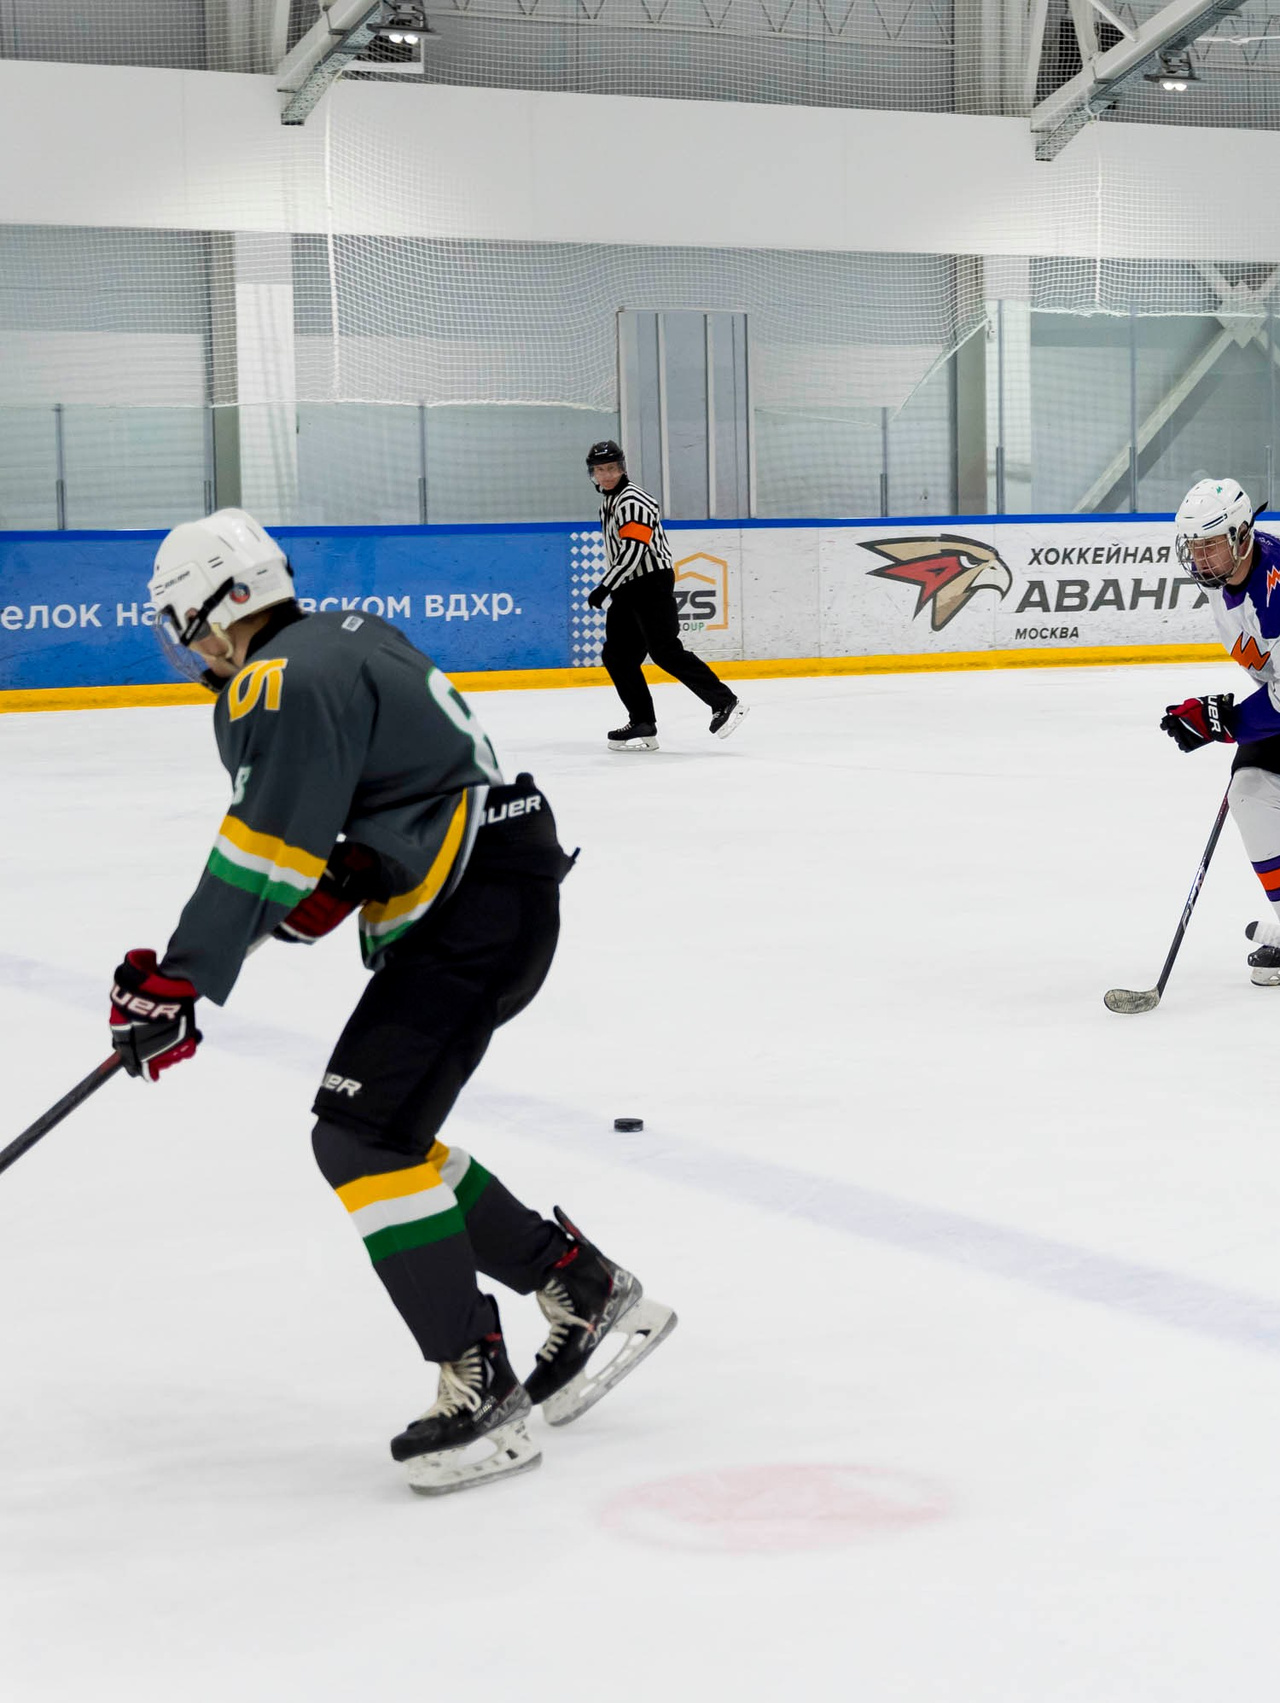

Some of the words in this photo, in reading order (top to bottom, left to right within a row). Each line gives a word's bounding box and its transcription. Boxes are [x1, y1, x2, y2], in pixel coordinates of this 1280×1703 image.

[1028, 543, 1171, 566] ХОККЕЙНАЯ
[0, 603, 102, 631] елок
[425, 592, 523, 622] вдхр.
[1015, 626, 1080, 641] МОСКВА
[1207, 695, 1222, 733] UER
[111, 984, 182, 1020] UER
